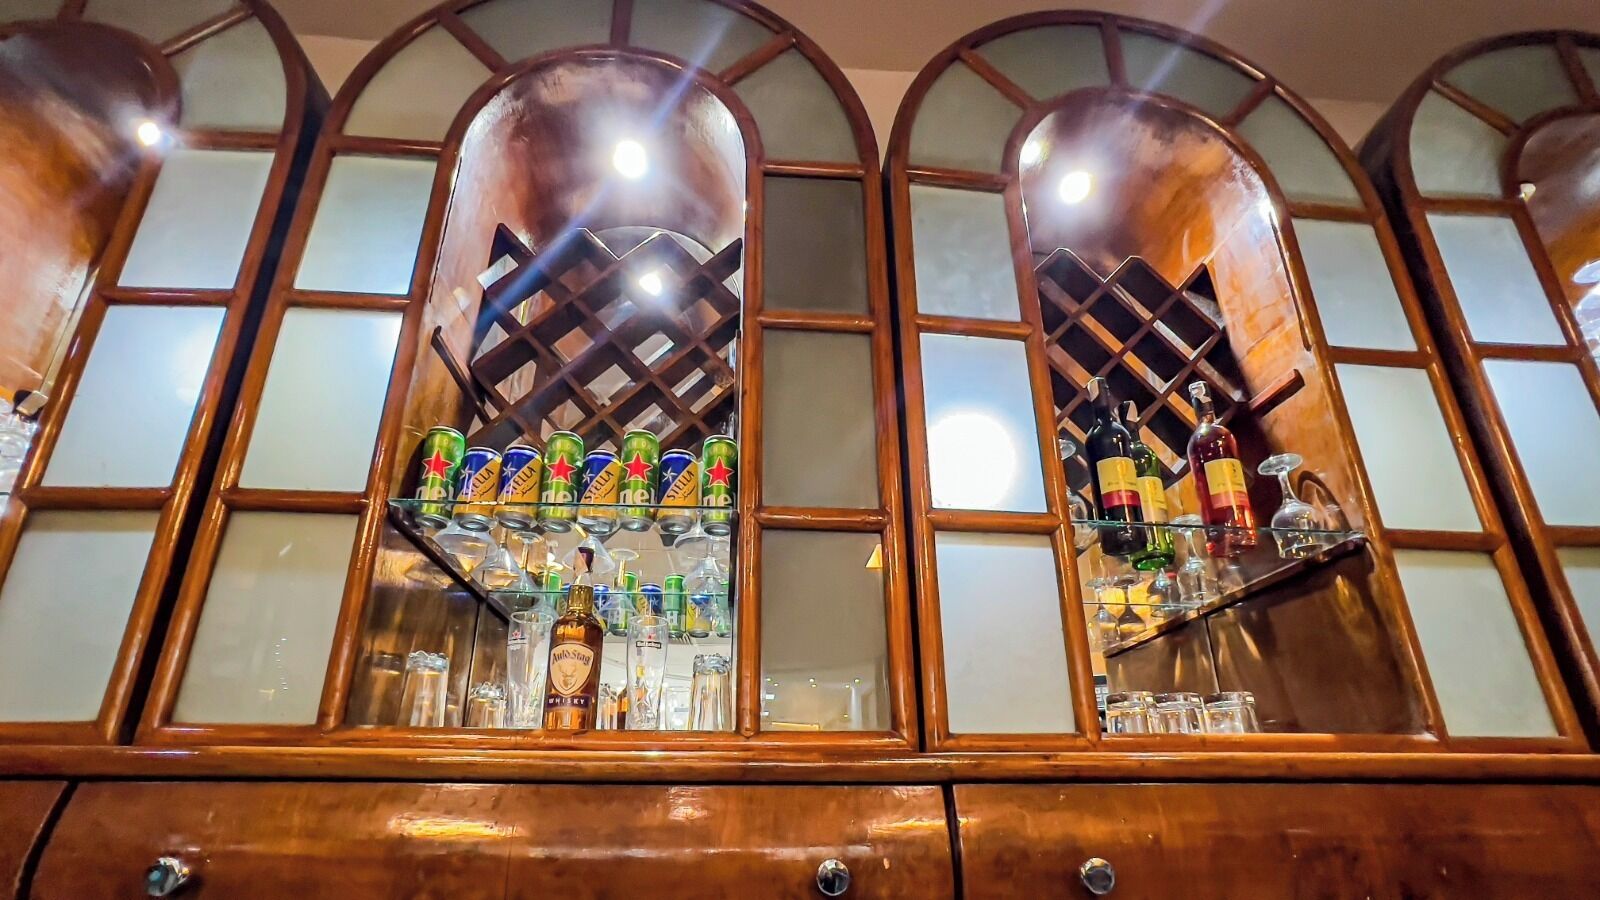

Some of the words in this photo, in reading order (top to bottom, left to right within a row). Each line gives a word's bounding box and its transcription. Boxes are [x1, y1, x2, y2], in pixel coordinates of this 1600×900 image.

[583, 469, 614, 502] STELLA
[666, 470, 695, 501] STELLA
[552, 649, 571, 665] Auld
[571, 650, 592, 666] Stag
